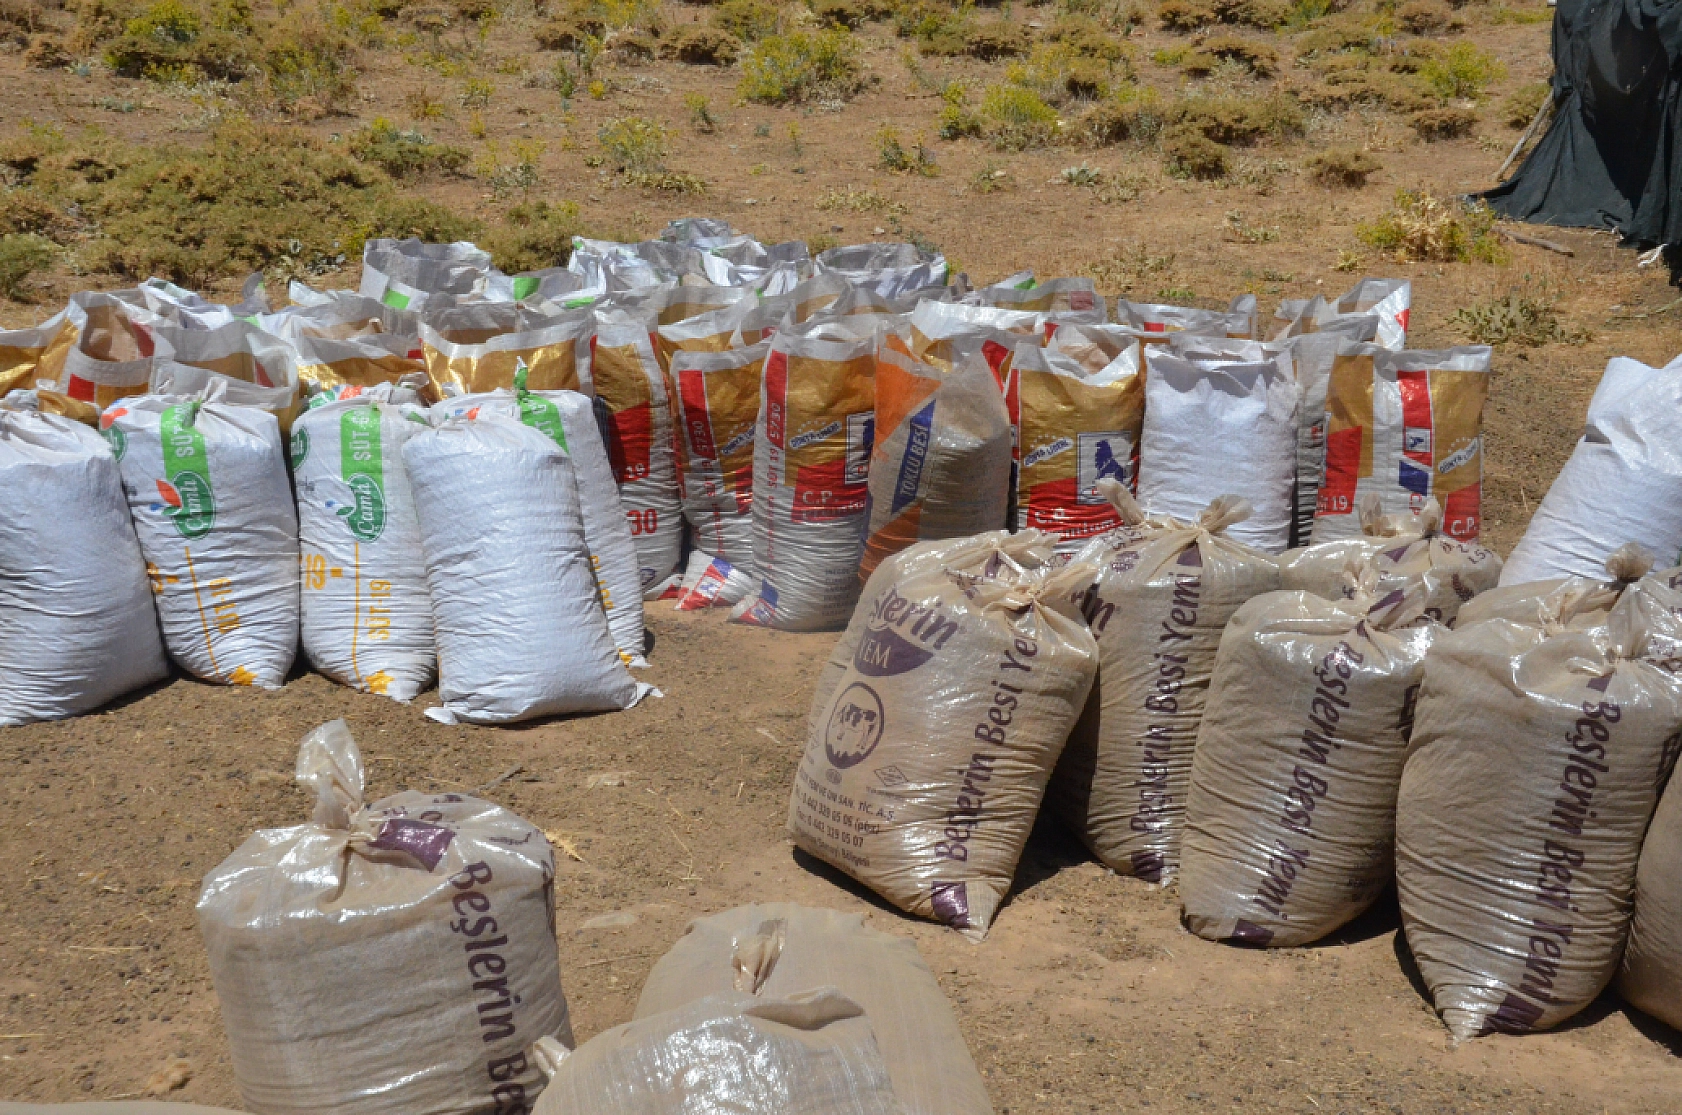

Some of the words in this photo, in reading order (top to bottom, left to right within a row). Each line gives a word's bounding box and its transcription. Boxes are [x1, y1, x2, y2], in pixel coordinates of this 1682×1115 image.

[349, 429, 372, 461] SÜT
[1332, 495, 1348, 511] 19
[364, 579, 391, 641] SÜT-19
[1159, 571, 1201, 645] Yemi
[974, 681, 1018, 746] Besi
[1000, 636, 1038, 674] Ye
[1146, 651, 1186, 714] Besi
[1280, 763, 1330, 840] Besi
[1548, 699, 1622, 836] Beşlerin
[1253, 838, 1310, 921] Yemi
[1535, 839, 1586, 914] Besi
[450, 860, 522, 1043] Beşlerin
[1519, 917, 1574, 1002] Yemi
